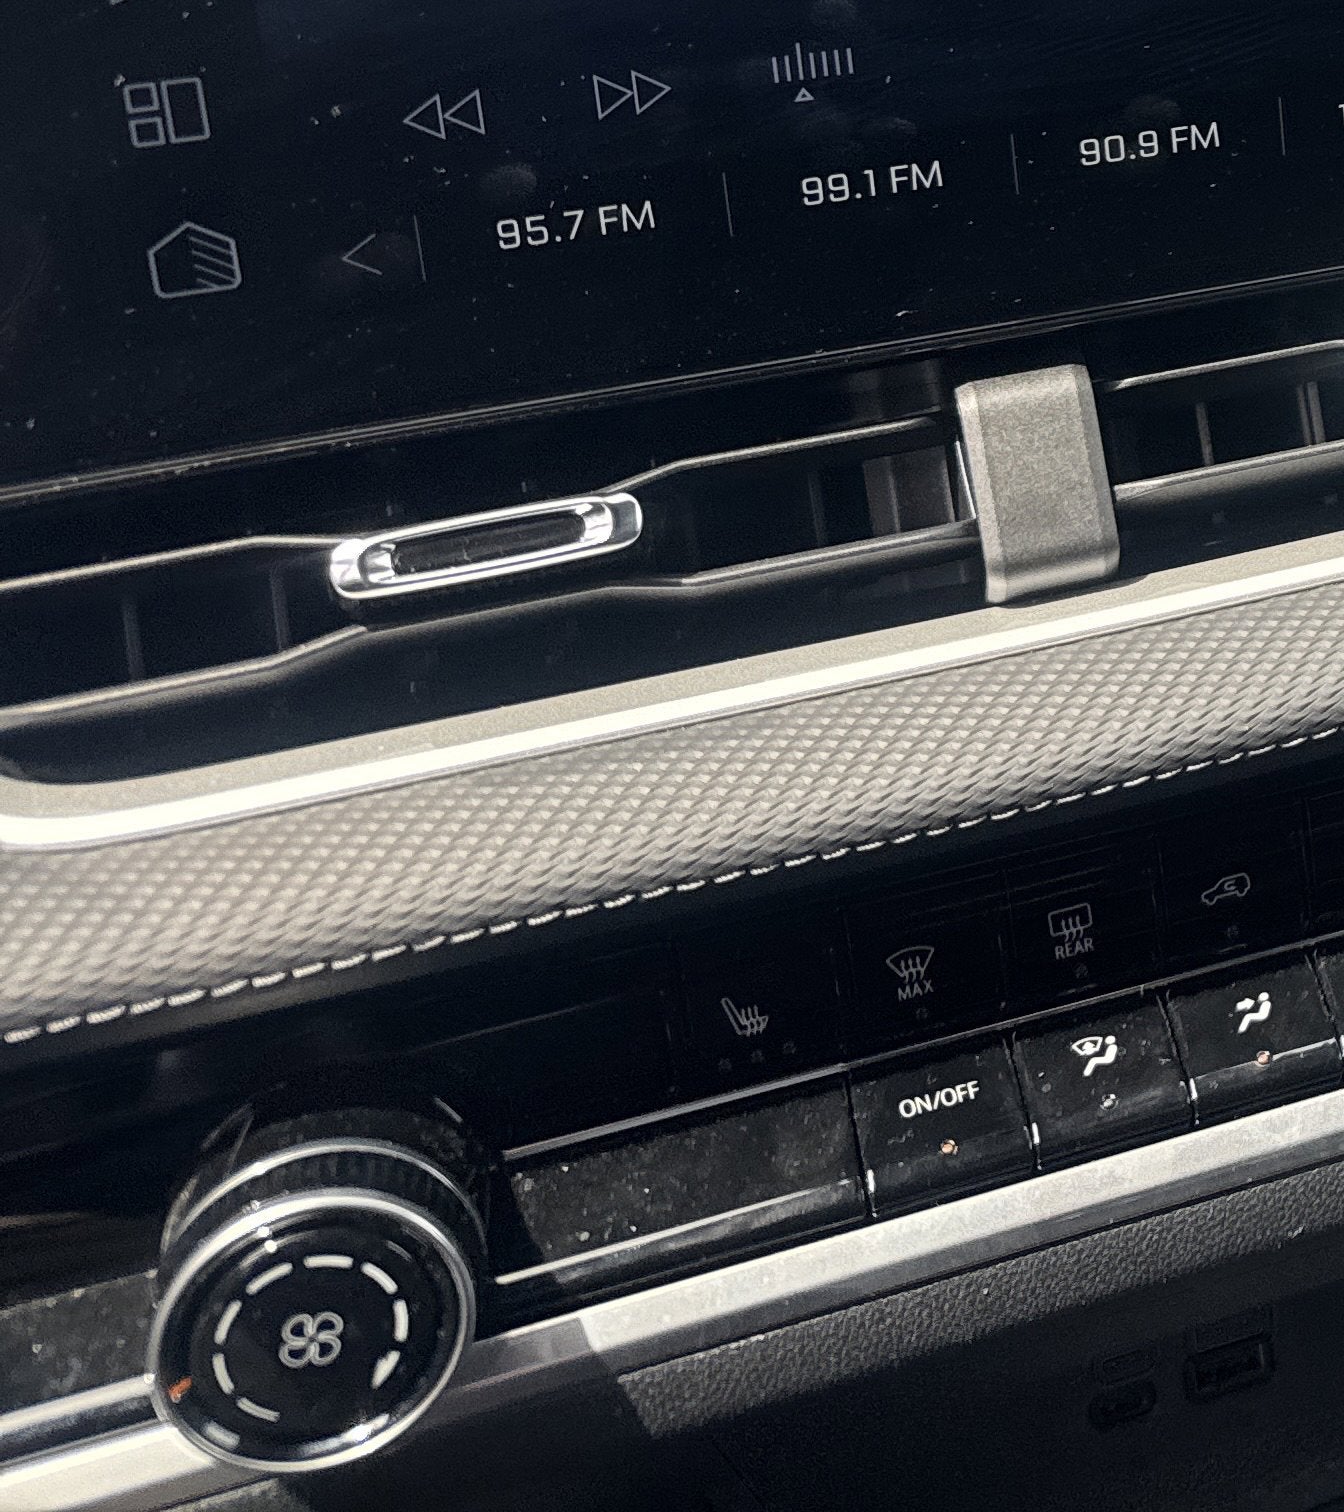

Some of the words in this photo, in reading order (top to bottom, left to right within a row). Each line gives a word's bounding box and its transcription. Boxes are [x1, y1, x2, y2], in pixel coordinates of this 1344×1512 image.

[1078, 129, 1160, 167] 90.9
[1169, 120, 1221, 155] FM
[800, 168, 877, 207] 99.1
[888, 159, 944, 195] FM
[495, 209, 586, 251] 95.7
[597, 199, 657, 237] FM
[1054, 937, 1095, 961] REAR
[897, 978, 935, 1002] MAX
[897, 1079, 981, 1119] ON/OFF
